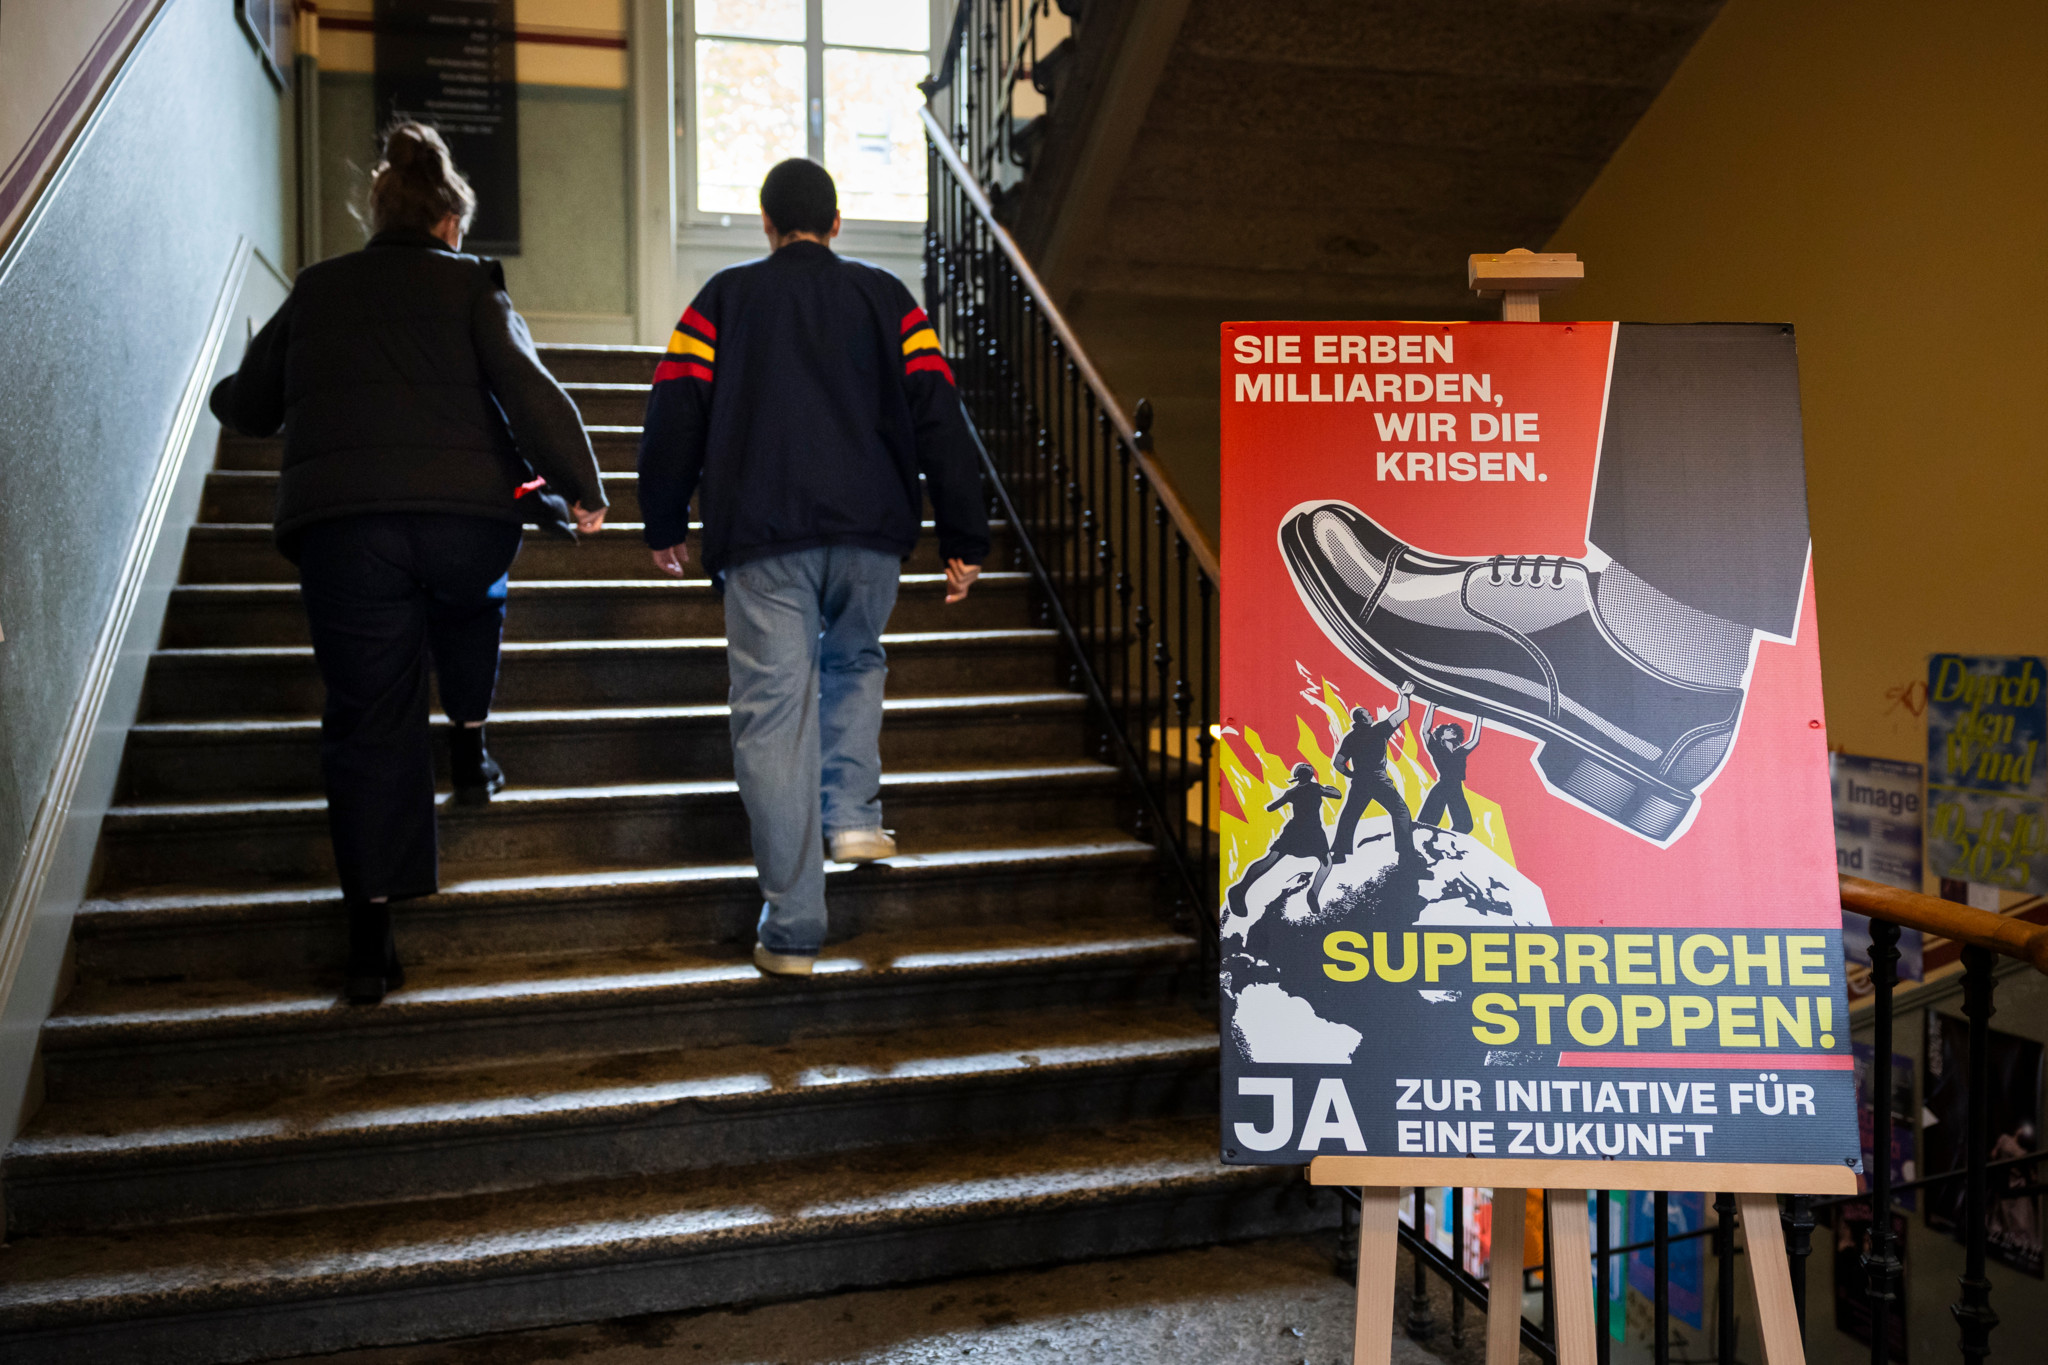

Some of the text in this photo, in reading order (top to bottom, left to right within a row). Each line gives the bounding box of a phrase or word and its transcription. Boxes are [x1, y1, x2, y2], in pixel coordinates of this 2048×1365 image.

[1234, 335, 1454, 364] SIE ERBEN
[1235, 373, 1504, 408] MILLIARDEN,
[1373, 412, 1540, 443] WIR DIE
[1376, 451, 1548, 483] KRISEN.
[1934, 657, 2039, 708] Durch
[1954, 697, 2014, 744] den
[1947, 731, 2038, 784] Wind
[1848, 778, 1920, 816] Image
[1322, 930, 1830, 986] SUPERREICHE
[1471, 992, 1836, 1049] STOPPEN!
[1233, 1077, 1368, 1152] JA
[1395, 1073, 1817, 1116] ZUR INITIATIVE FÜR
[1397, 1120, 1714, 1157] EINE ZUKUNFT
